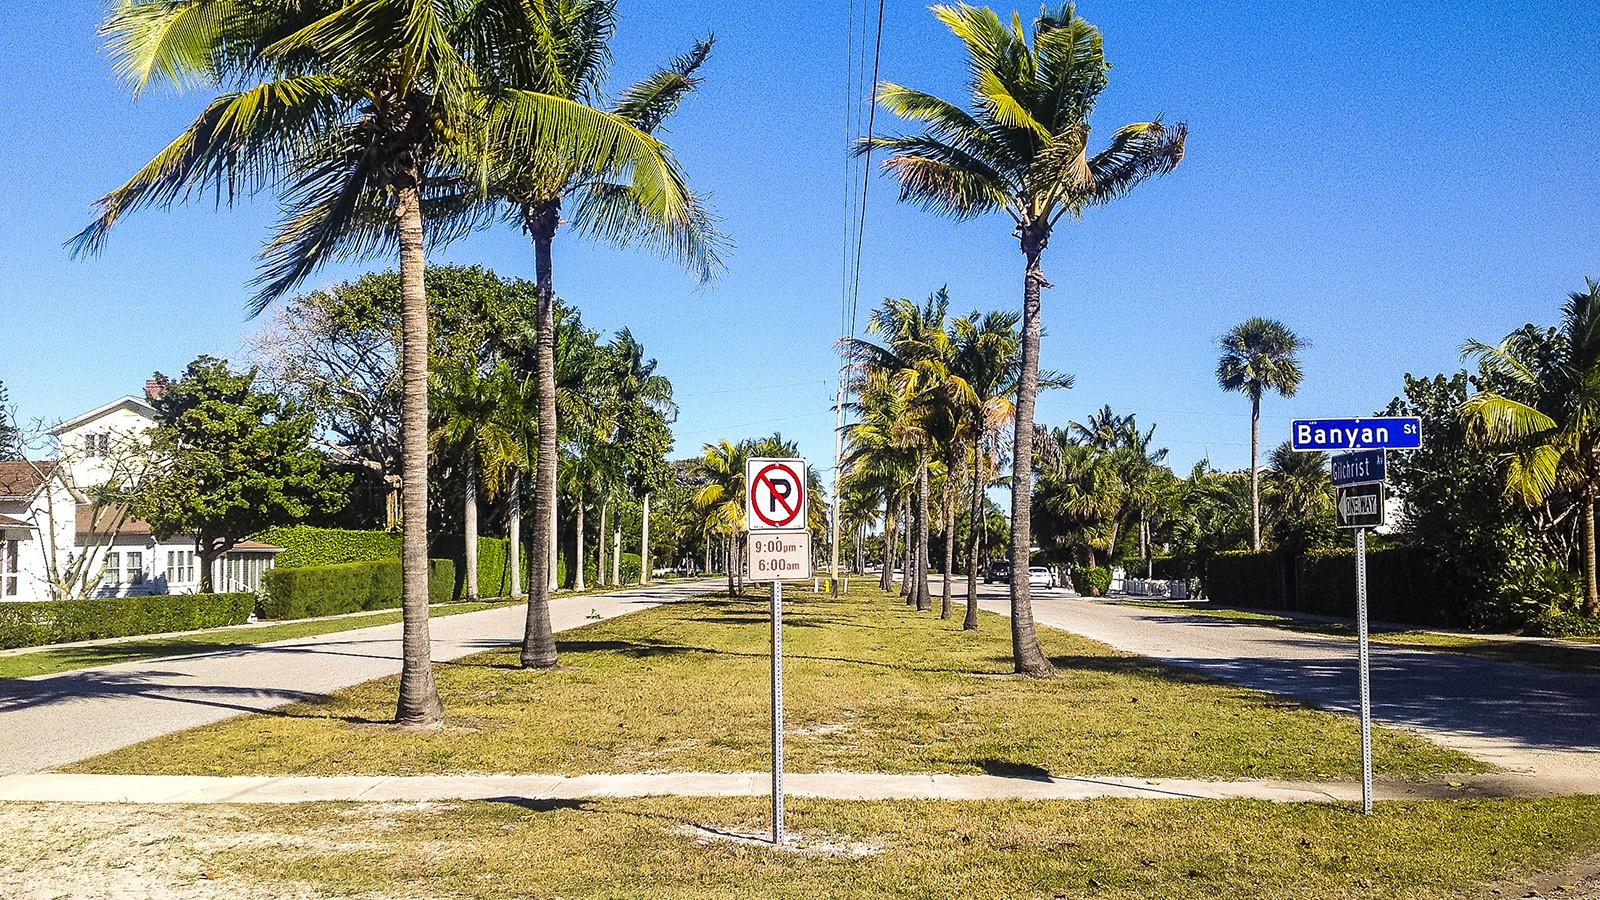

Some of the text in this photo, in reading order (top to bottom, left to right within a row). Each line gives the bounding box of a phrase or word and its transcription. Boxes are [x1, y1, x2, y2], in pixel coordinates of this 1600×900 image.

[1297, 423, 1417, 448] Banyan St
[1332, 457, 1370, 481] Gilchrist
[769, 478, 792, 513] P
[1346, 496, 1376, 514] ONE WAY
[758, 558, 800, 572] 6:00am
